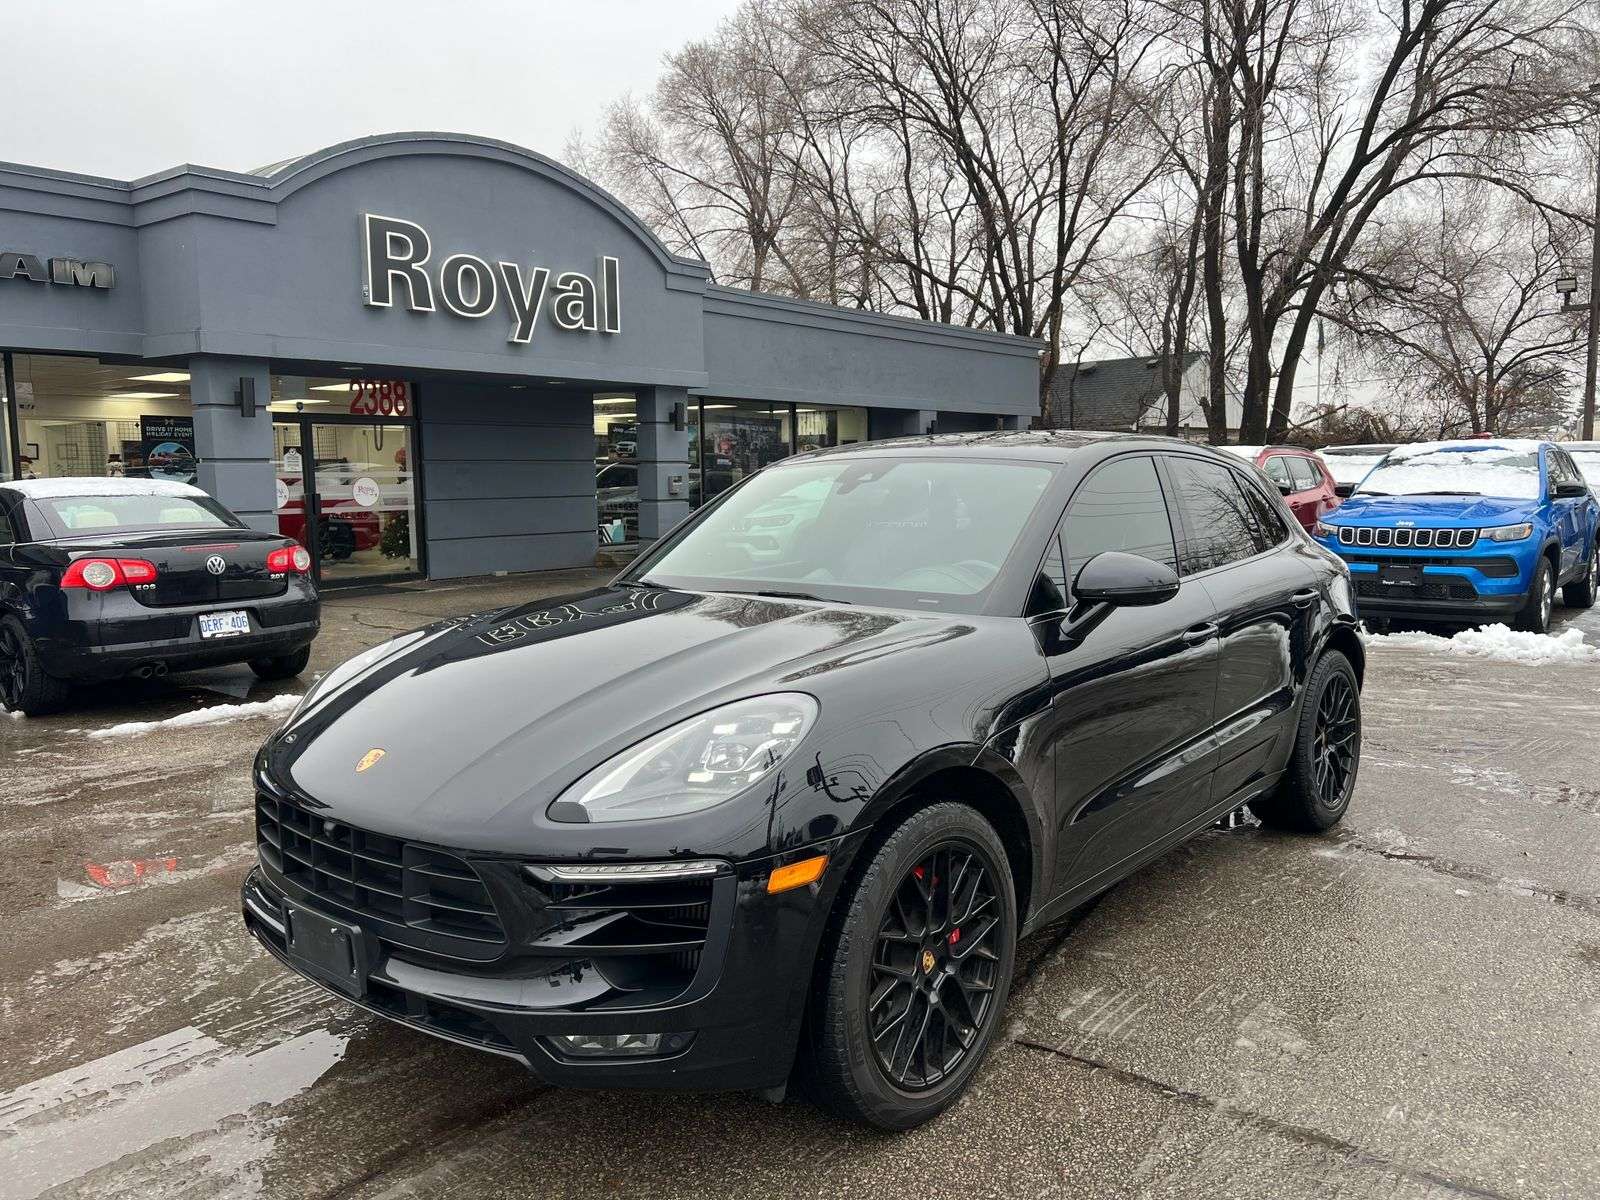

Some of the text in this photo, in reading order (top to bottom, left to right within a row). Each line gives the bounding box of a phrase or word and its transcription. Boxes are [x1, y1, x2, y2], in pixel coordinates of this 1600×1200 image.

[362, 212, 621, 343] Royal
[350, 379, 408, 416] 2388
[135, 583, 157, 591] EOS
[230, 615, 249, 631] 406
